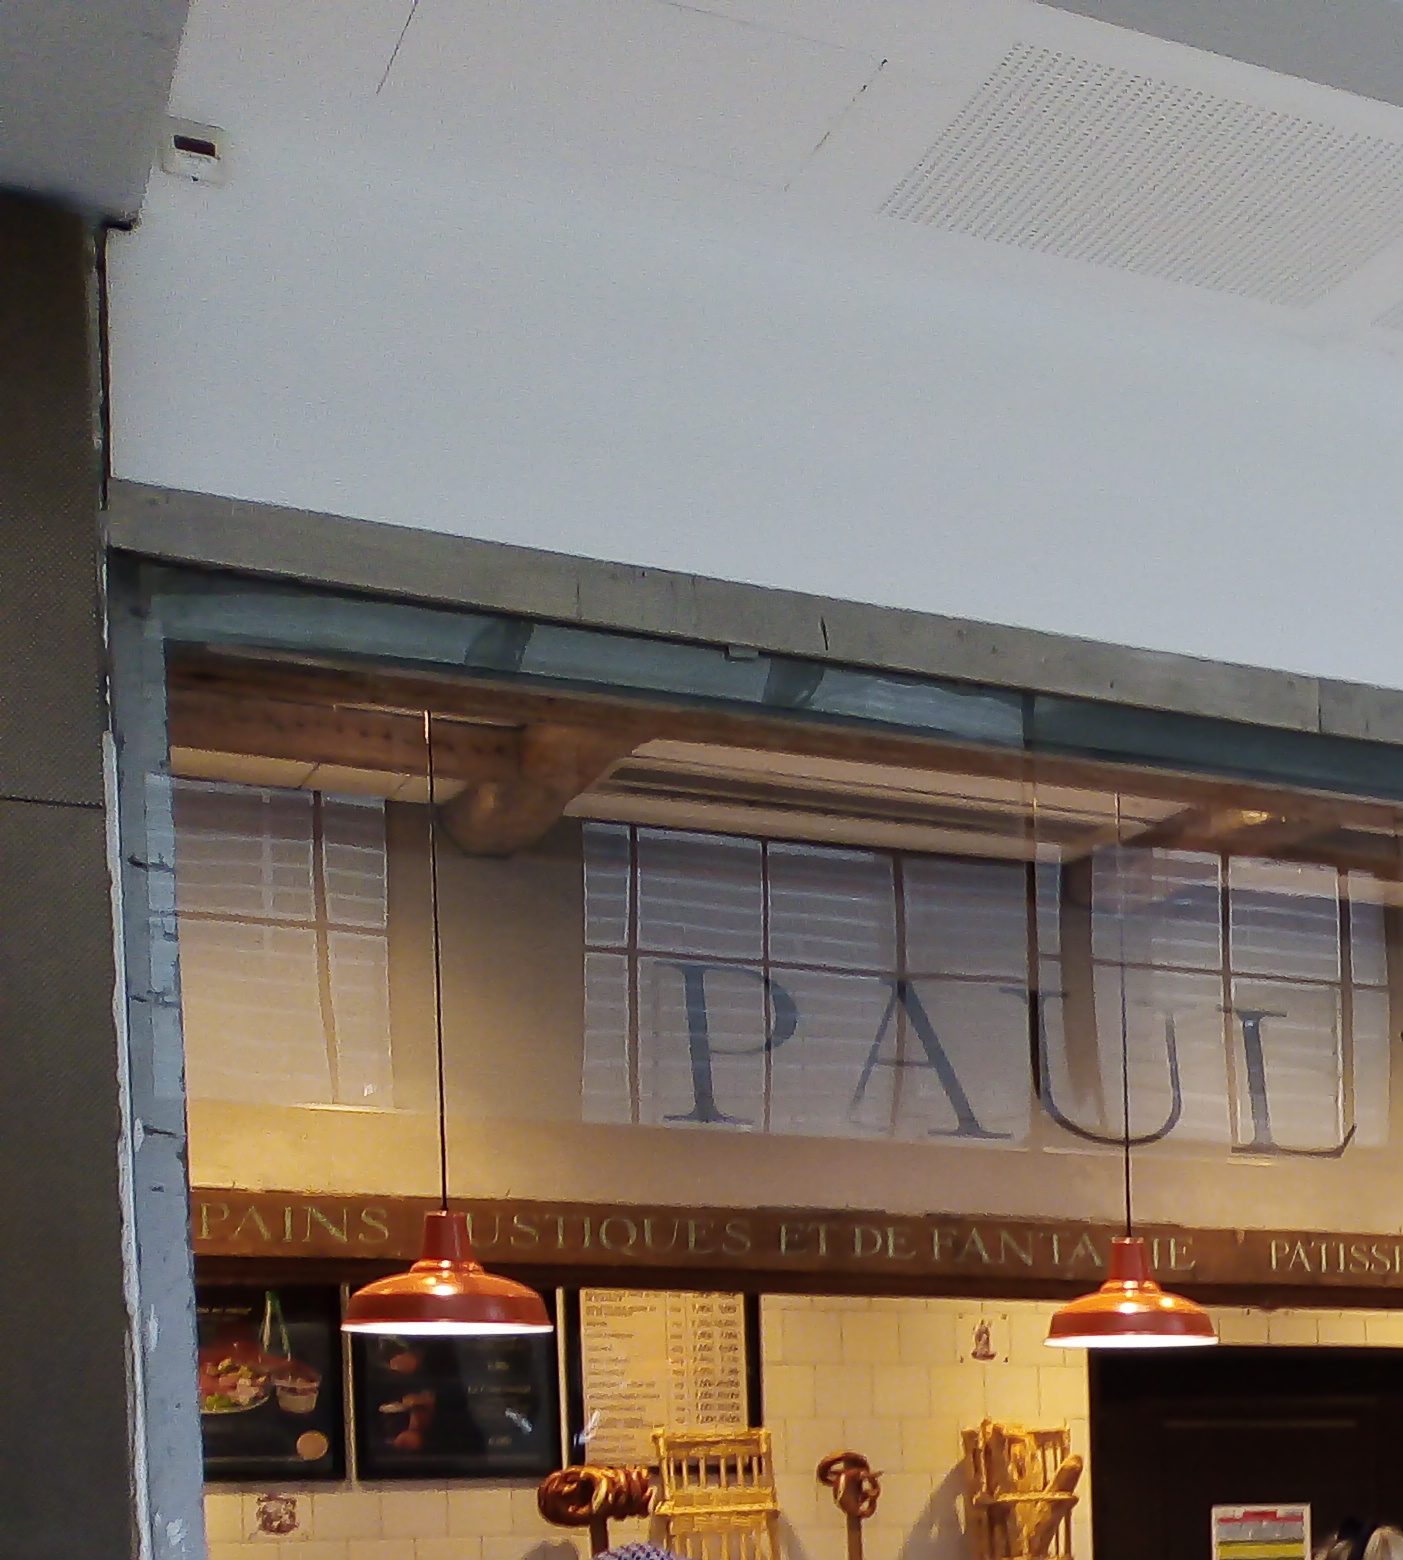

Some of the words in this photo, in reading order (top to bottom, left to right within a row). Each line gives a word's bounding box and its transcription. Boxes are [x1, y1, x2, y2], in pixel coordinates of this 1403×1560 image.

[654, 961, 1357, 1159] PAUL
[196, 1202, 390, 1244] PAINS
[464, 1212, 753, 1255] USTIQUES
[779, 1222, 837, 1257] ET
[853, 1225, 916, 1259] DE
[932, 1227, 1197, 1271] FANTAIE
